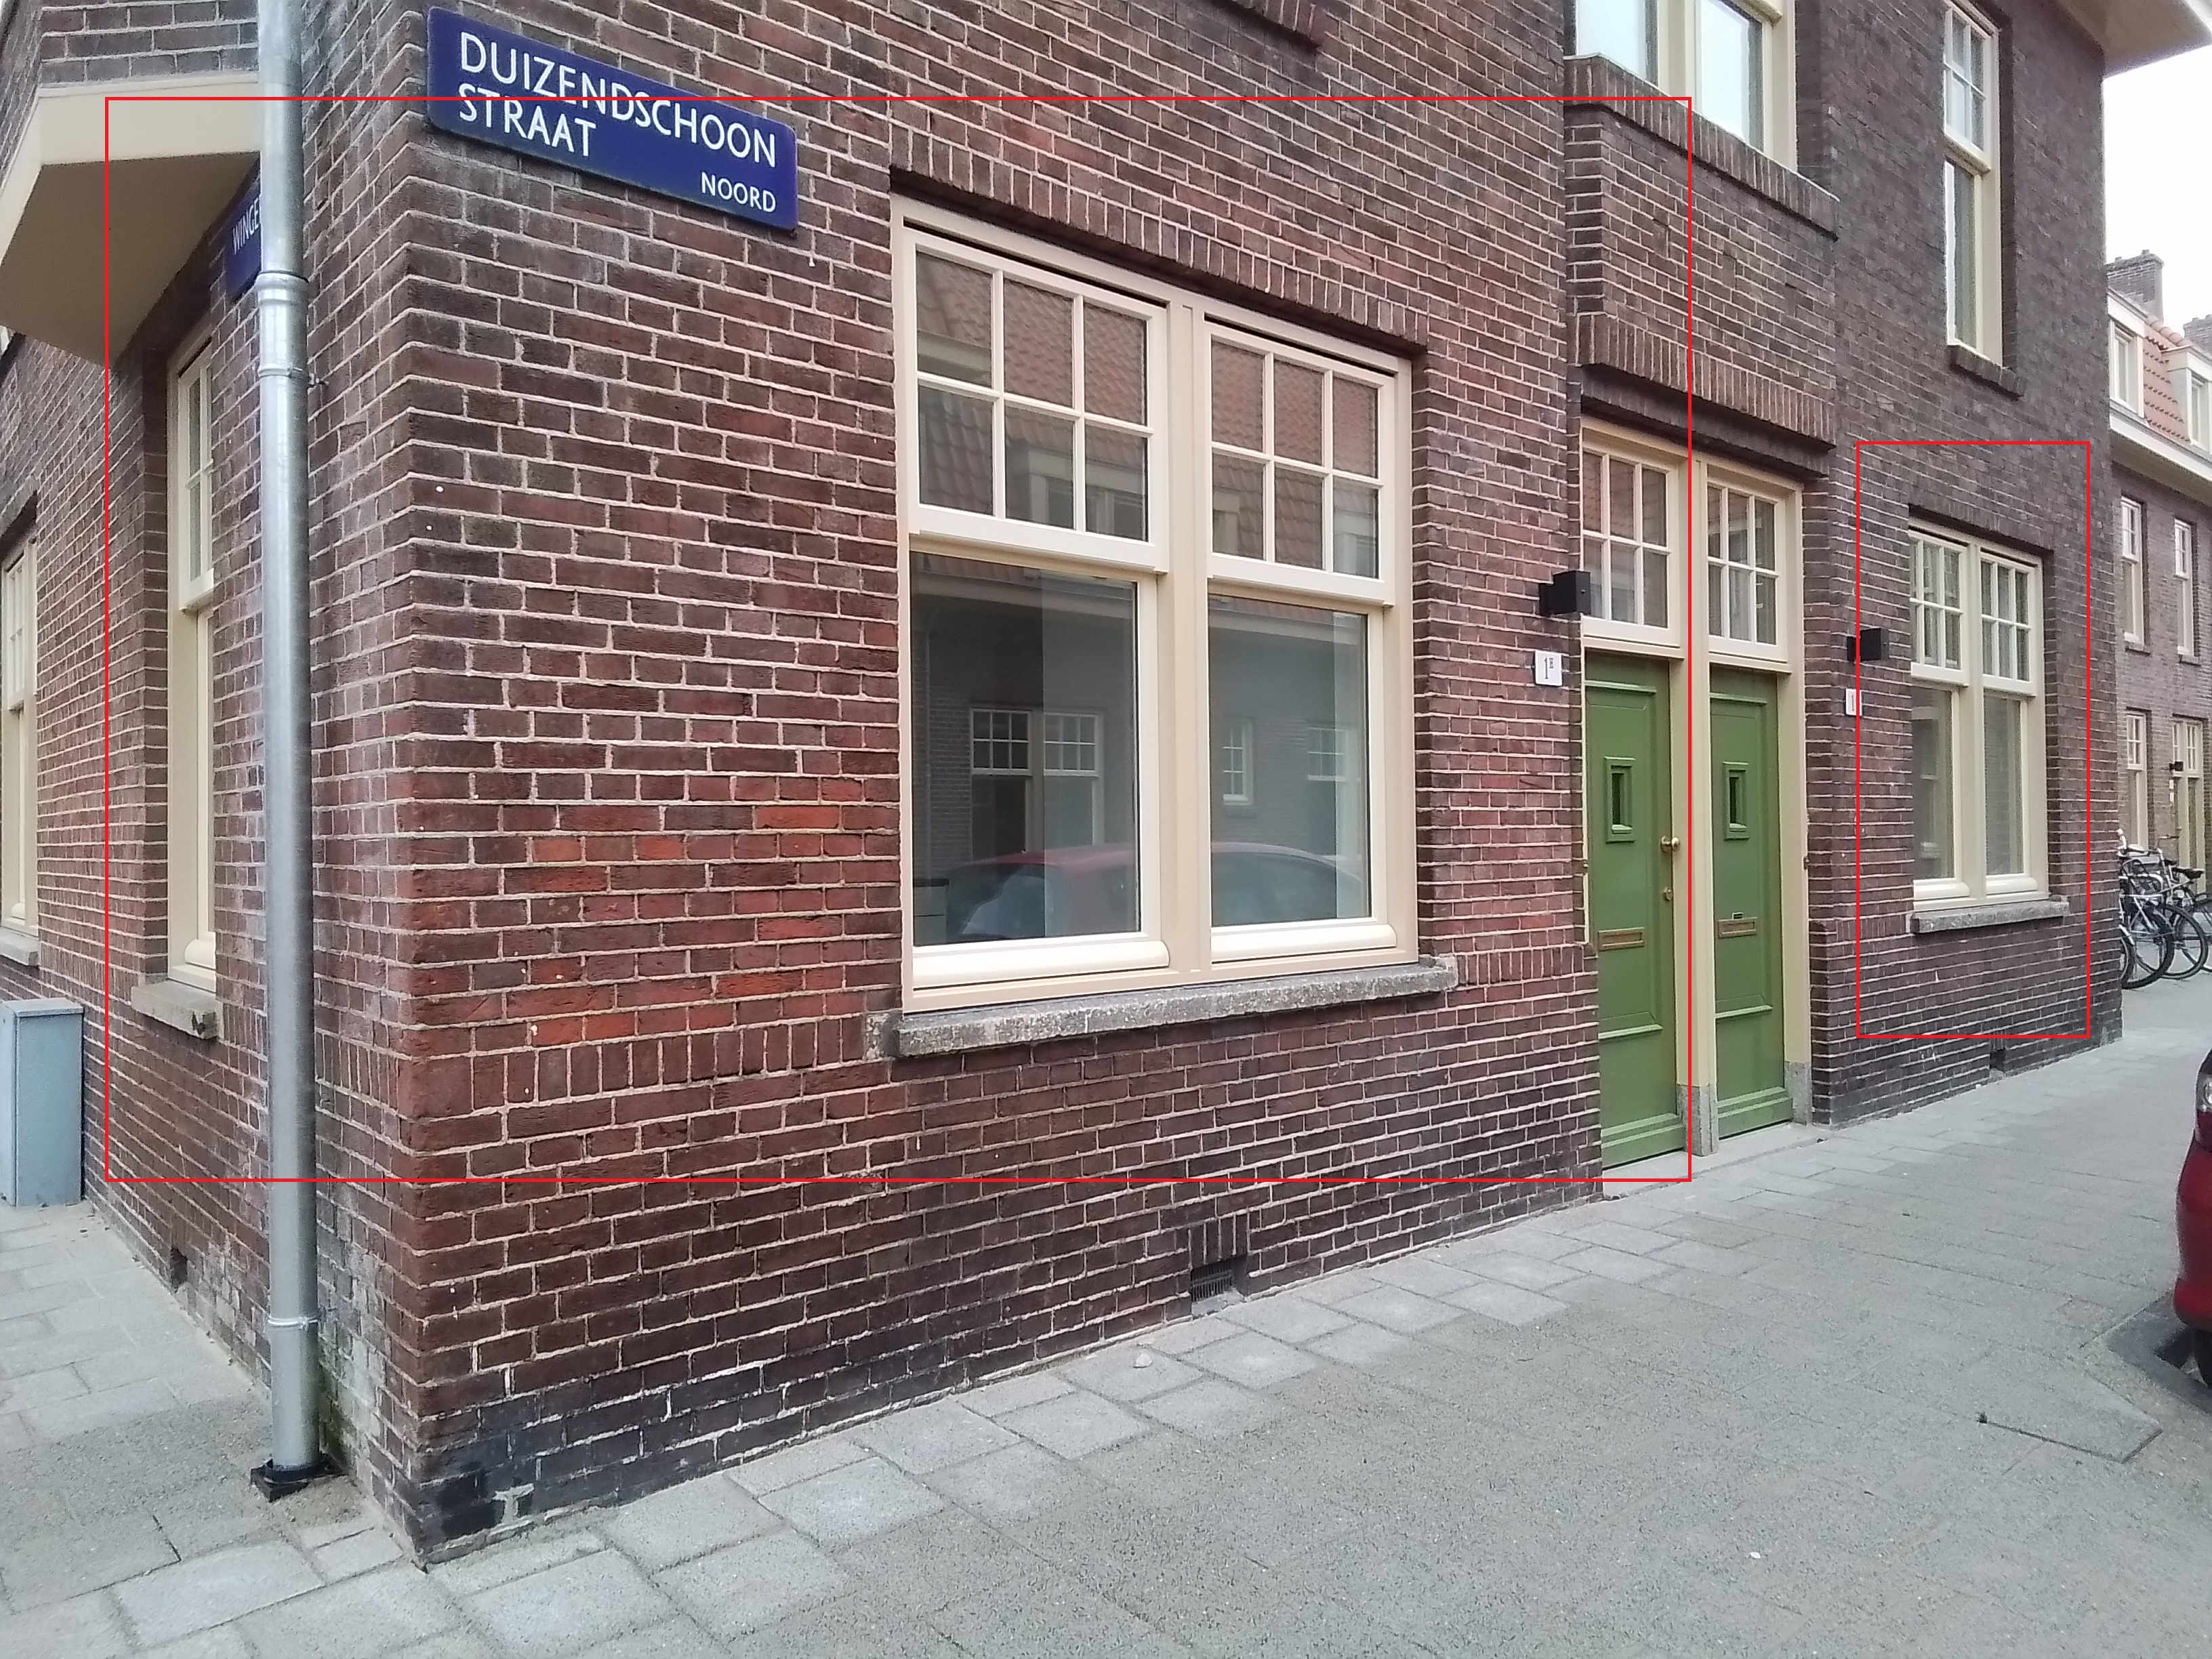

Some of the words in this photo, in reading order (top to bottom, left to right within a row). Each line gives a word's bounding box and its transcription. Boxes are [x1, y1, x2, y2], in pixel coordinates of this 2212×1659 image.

[459, 83, 596, 157] STRAAT
[460, 32, 776, 168] DUIZENDSCHOON
[701, 171, 777, 213] NOORD
